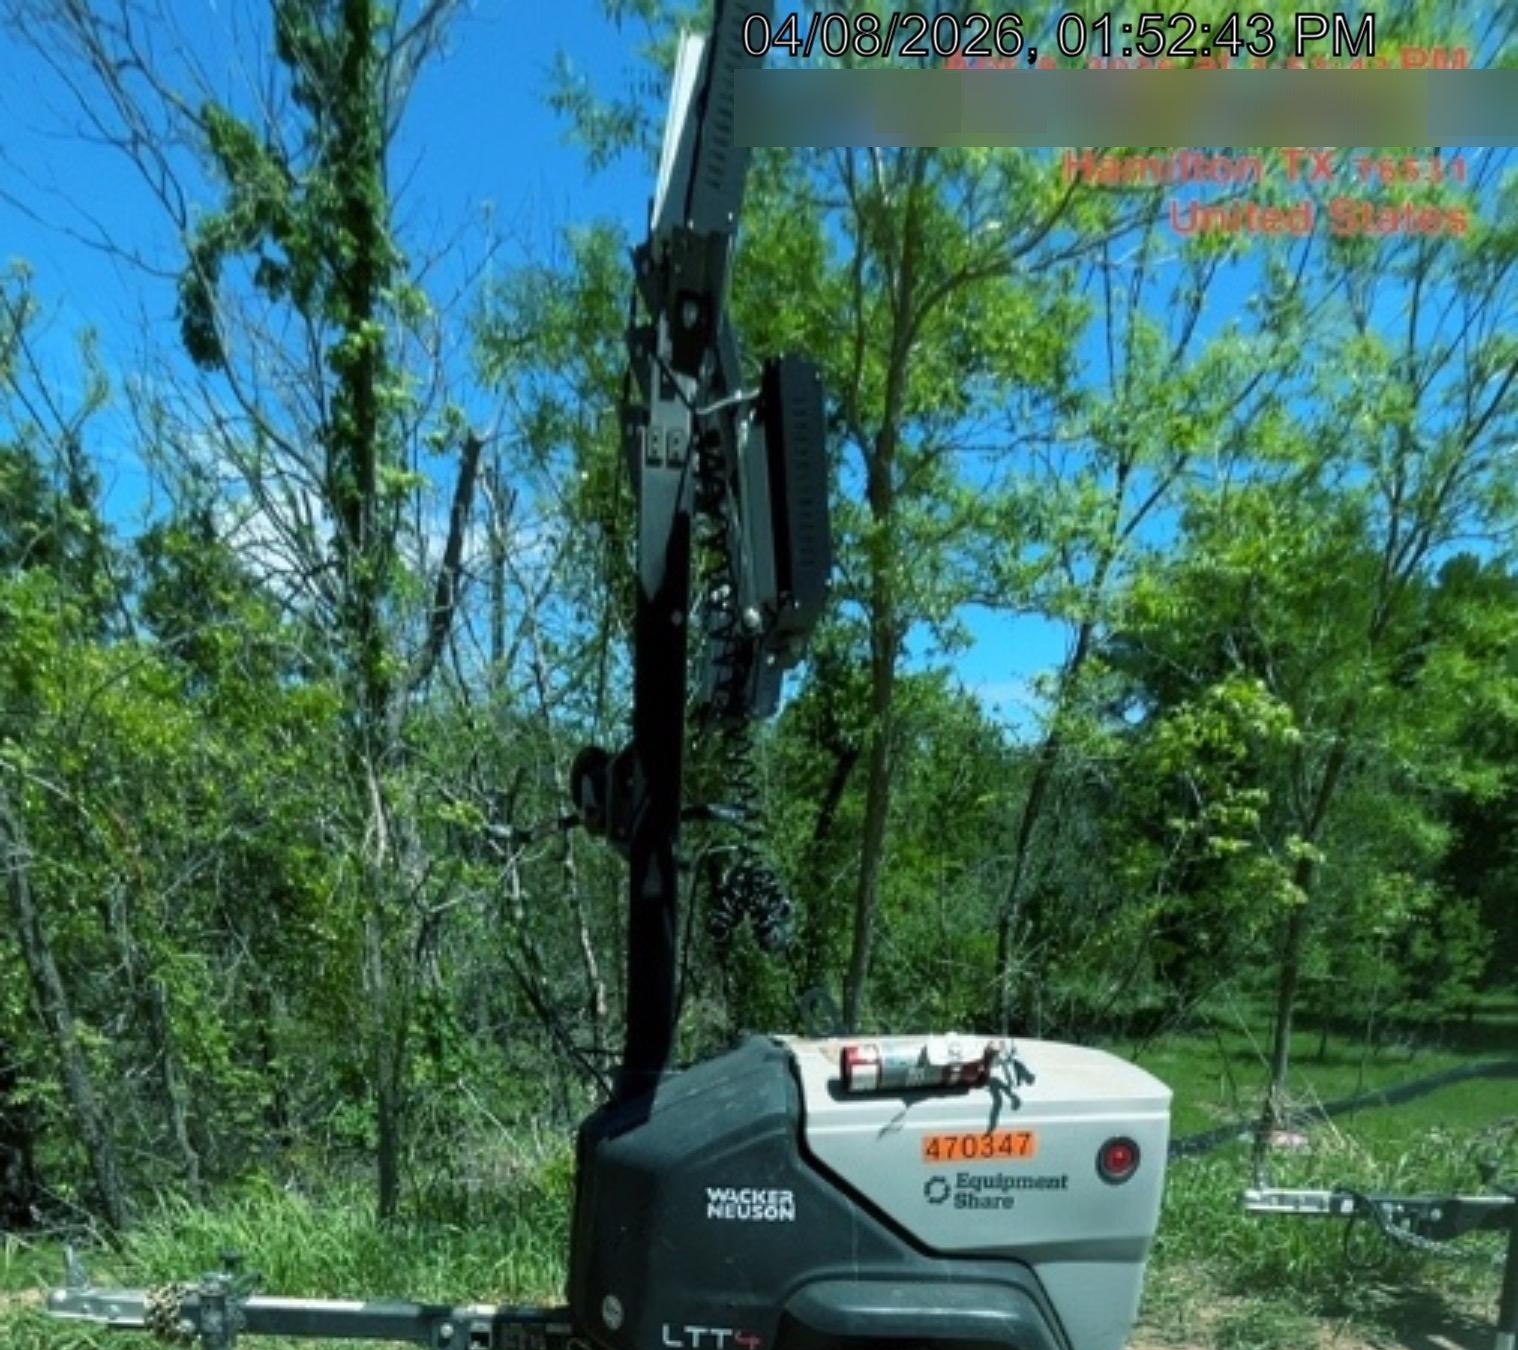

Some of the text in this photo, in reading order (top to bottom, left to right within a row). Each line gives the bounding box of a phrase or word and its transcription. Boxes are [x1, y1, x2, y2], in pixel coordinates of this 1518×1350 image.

[925, 1132, 1032, 1161] 470347
[956, 1172, 1068, 1192] Equipment
[706, 1187, 793, 1204] WACKER
[953, 1193, 1015, 1209] Share
[707, 1203, 796, 1221] NEUSON
[662, 1322, 761, 1350] LTT4
